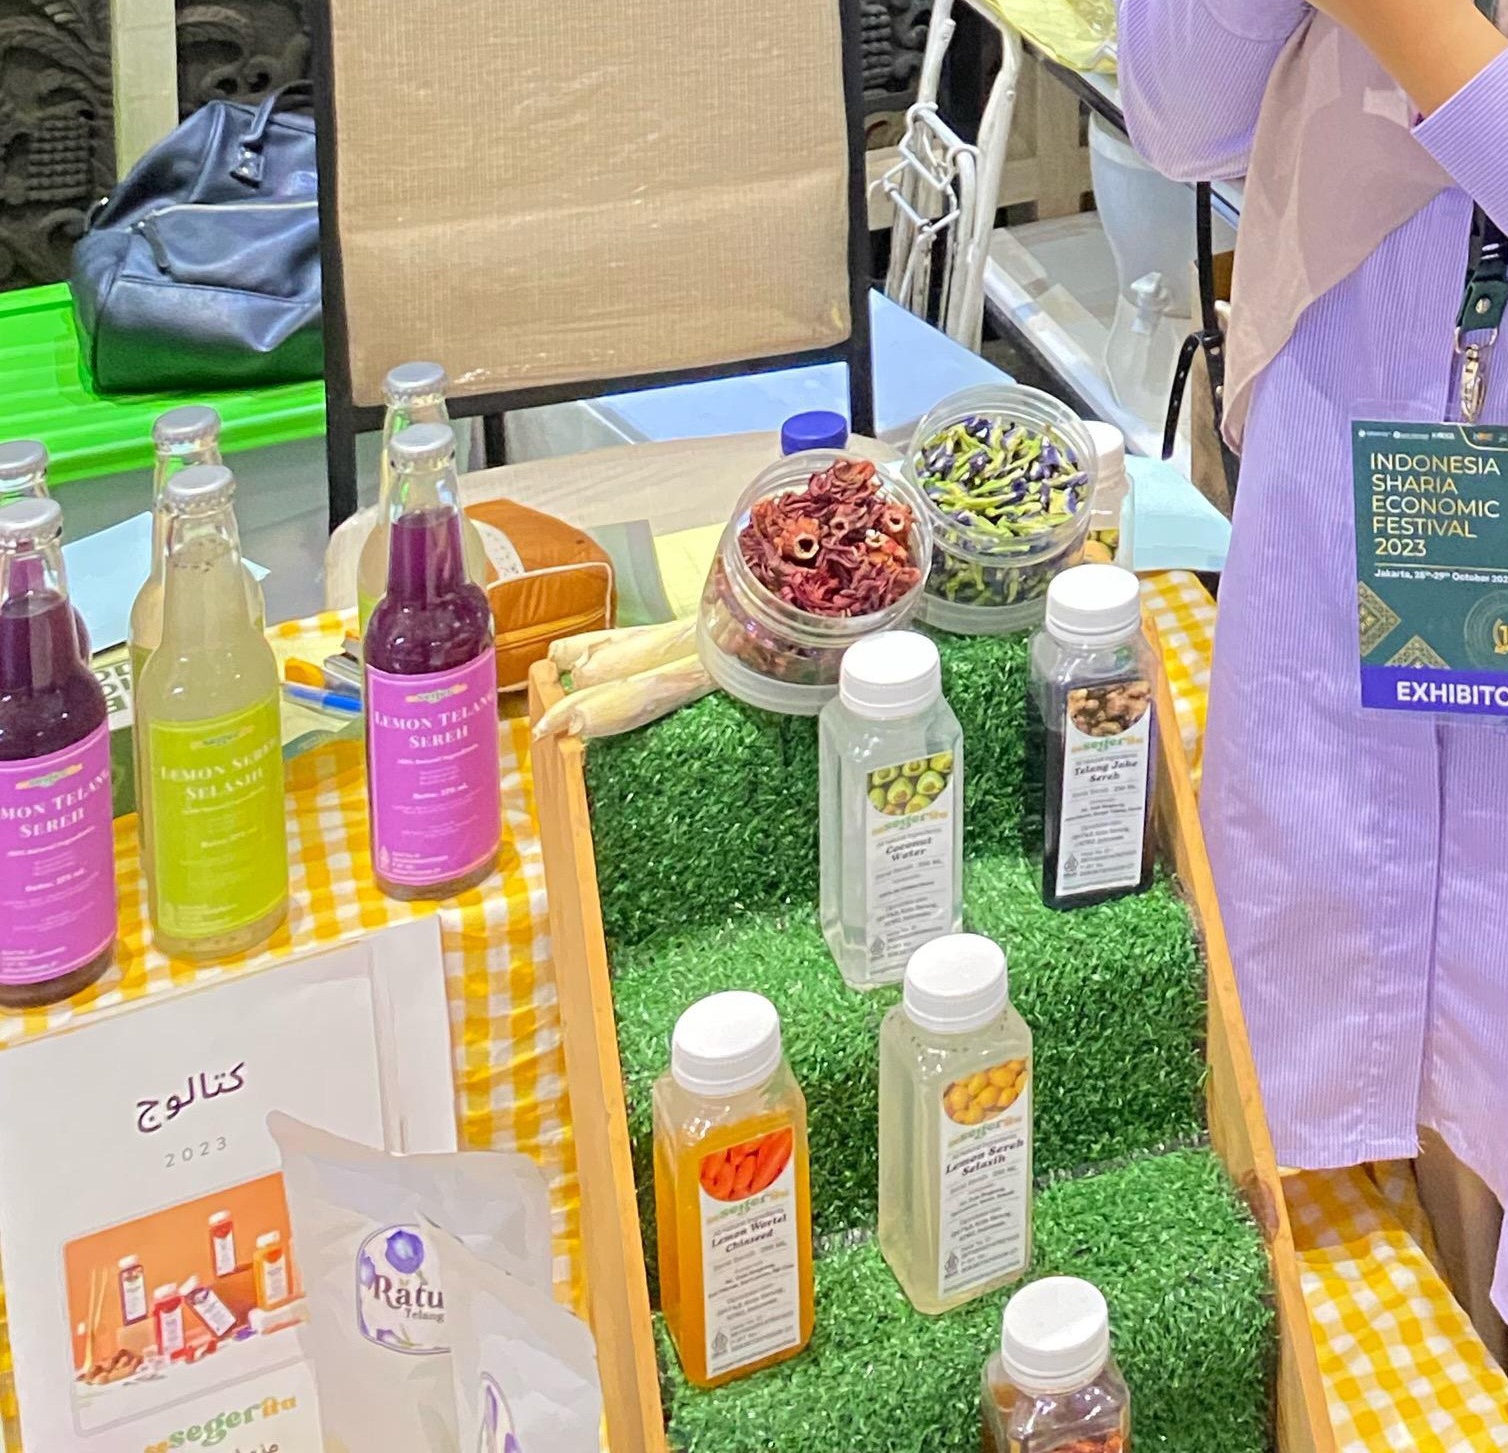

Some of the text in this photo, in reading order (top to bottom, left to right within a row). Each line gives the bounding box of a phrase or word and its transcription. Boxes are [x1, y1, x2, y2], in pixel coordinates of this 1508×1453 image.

[1370, 452, 1501, 476] INDONESIA
[1371, 473, 1459, 495] SHARIA
[1372, 495, 1501, 519] ECONOMIC
[1372, 516, 1478, 539] FESTIVAL
[1374, 537, 1427, 558] 2023
[1374, 568, 1413, 580] Jakarta,
[1451, 571, 1491, 583] October
[375, 711, 433, 730] LEMON
[409, 725, 469, 748] SEREH
[160, 765, 226, 782] LEMON
[1074, 760, 1138, 776] Telang Jahe
[1089, 773, 1120, 783] Sereh
[19, 807, 85, 839] SEREH
[886, 836, 933, 855] Coconut
[891, 848, 927, 862] Water
[136, 1061, 245, 1133] كتالوج
[165, 1136, 227, 1168] 2023
[945, 1139, 1024, 1175] Lemon Sereh
[961, 1156, 1007, 1177] Selasih
[711, 1213, 787, 1248] Lemon Wortel
[725, 1229, 774, 1253] Chiaseed
[373, 1274, 445, 1309] Ratu
[404, 1308, 445, 1324] Telang
